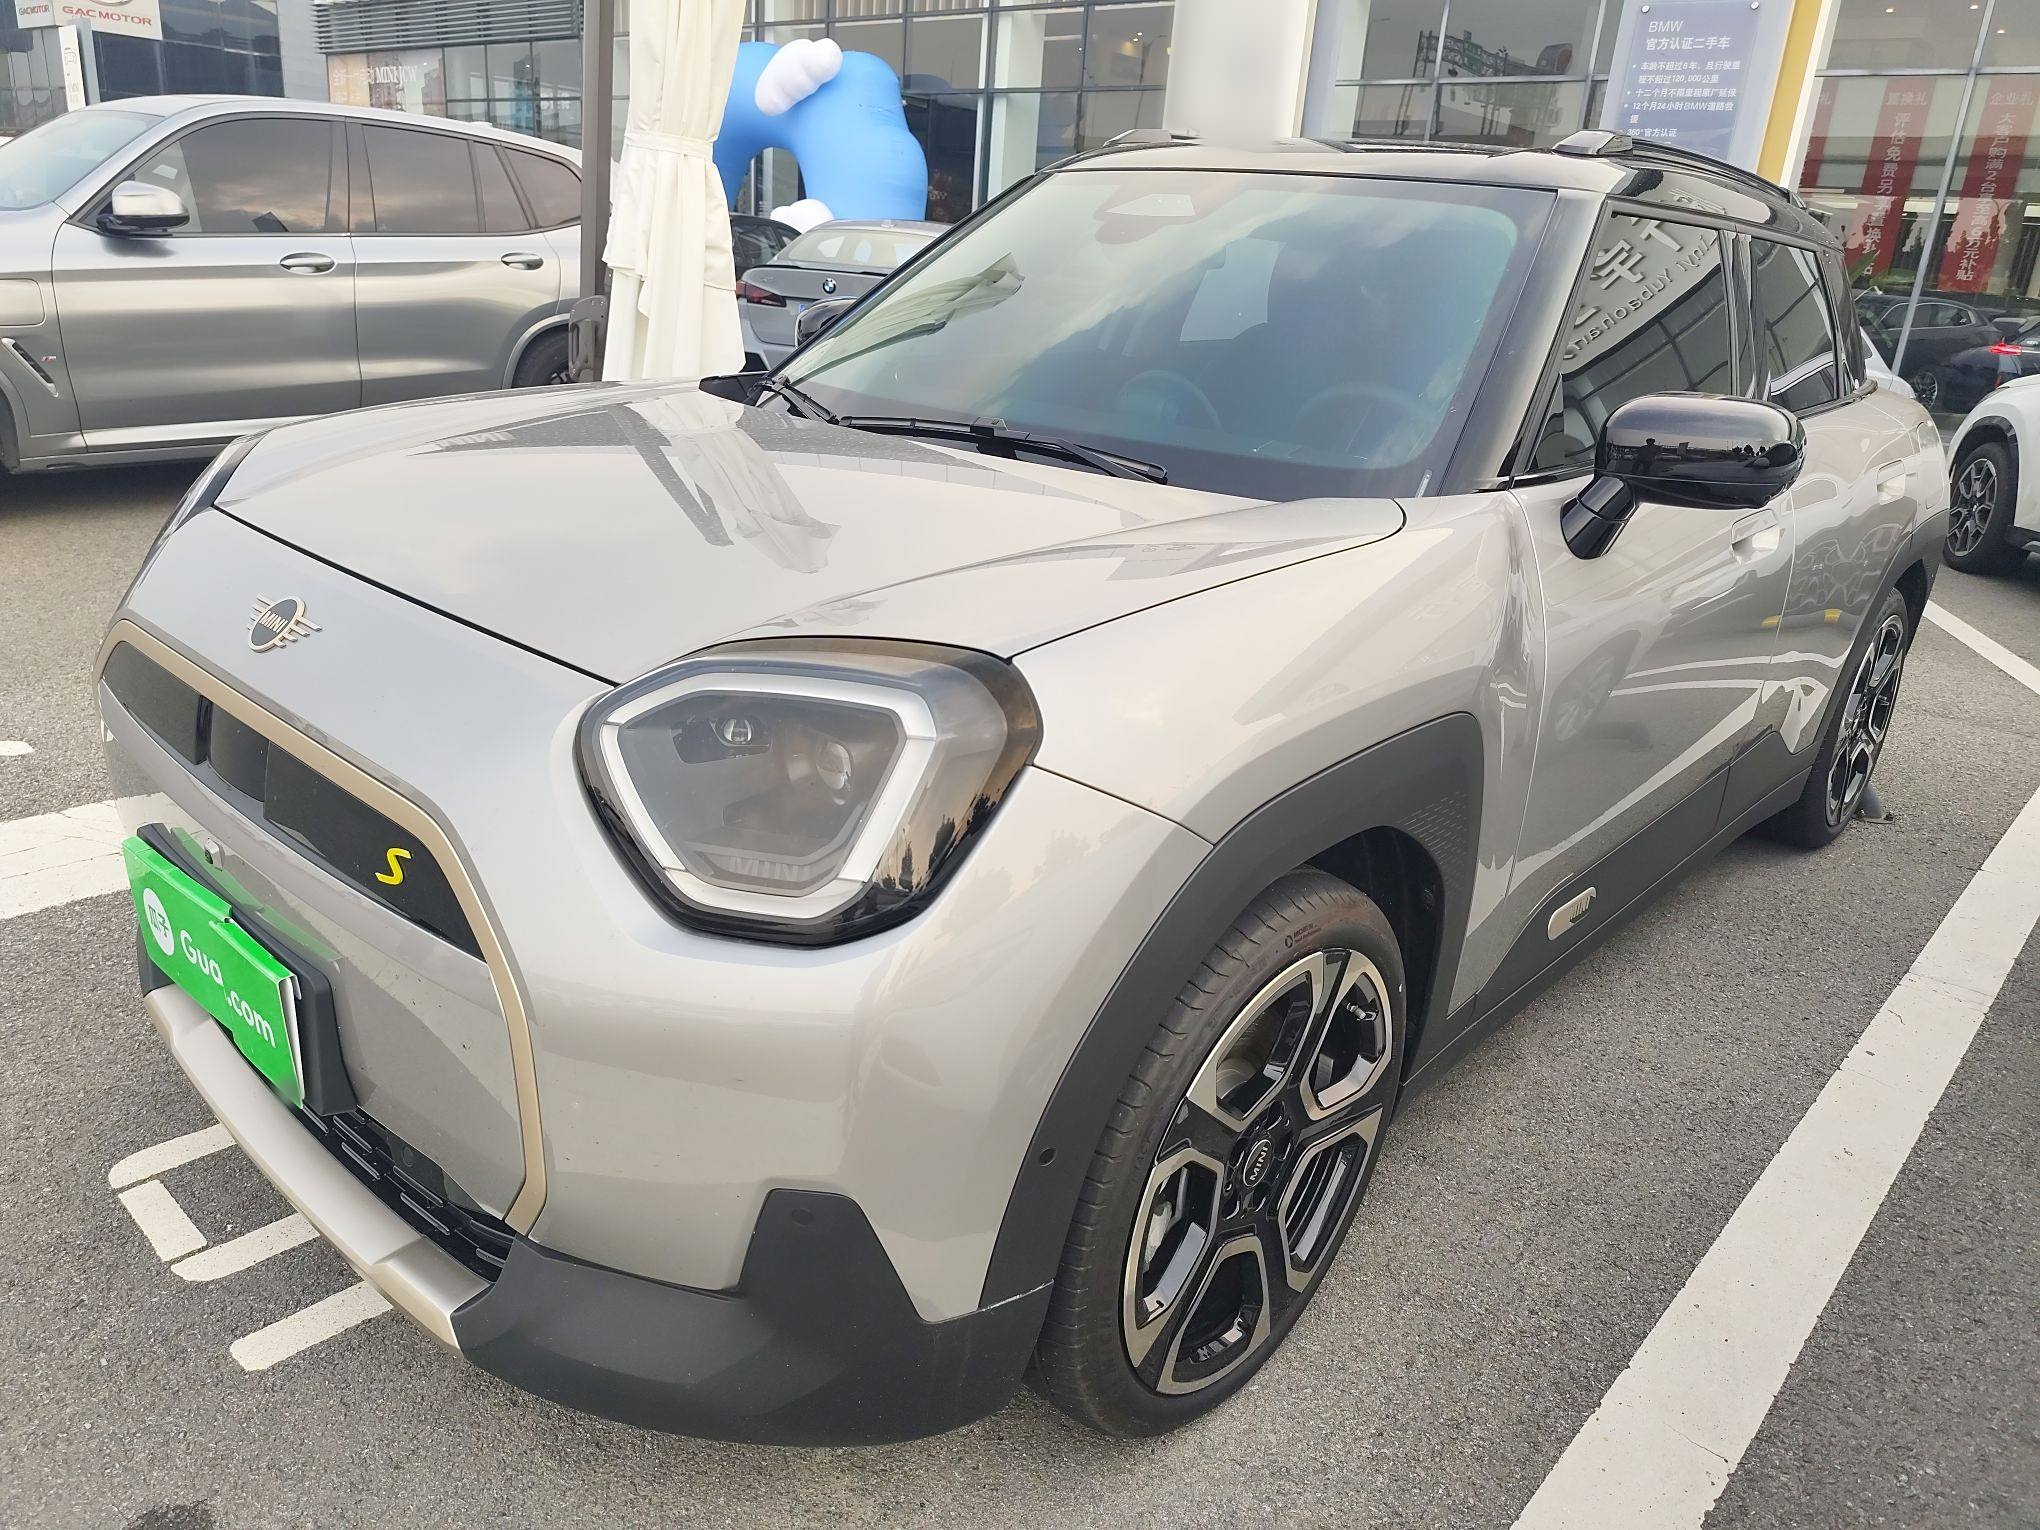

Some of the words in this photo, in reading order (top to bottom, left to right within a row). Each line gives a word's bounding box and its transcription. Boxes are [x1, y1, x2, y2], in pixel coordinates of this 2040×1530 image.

[62, 5, 97, 19] GAC
[98, 11, 153, 26] MOTOR
[1648, 20, 1684, 33] BMW
[1646, 37, 1731, 51] 官方认证二手车
[1989, 92, 2034, 106] 企业礼
[259, 610, 289, 634] MINI
[374, 847, 412, 885] S
[1249, 1146, 1268, 1181] MINI
